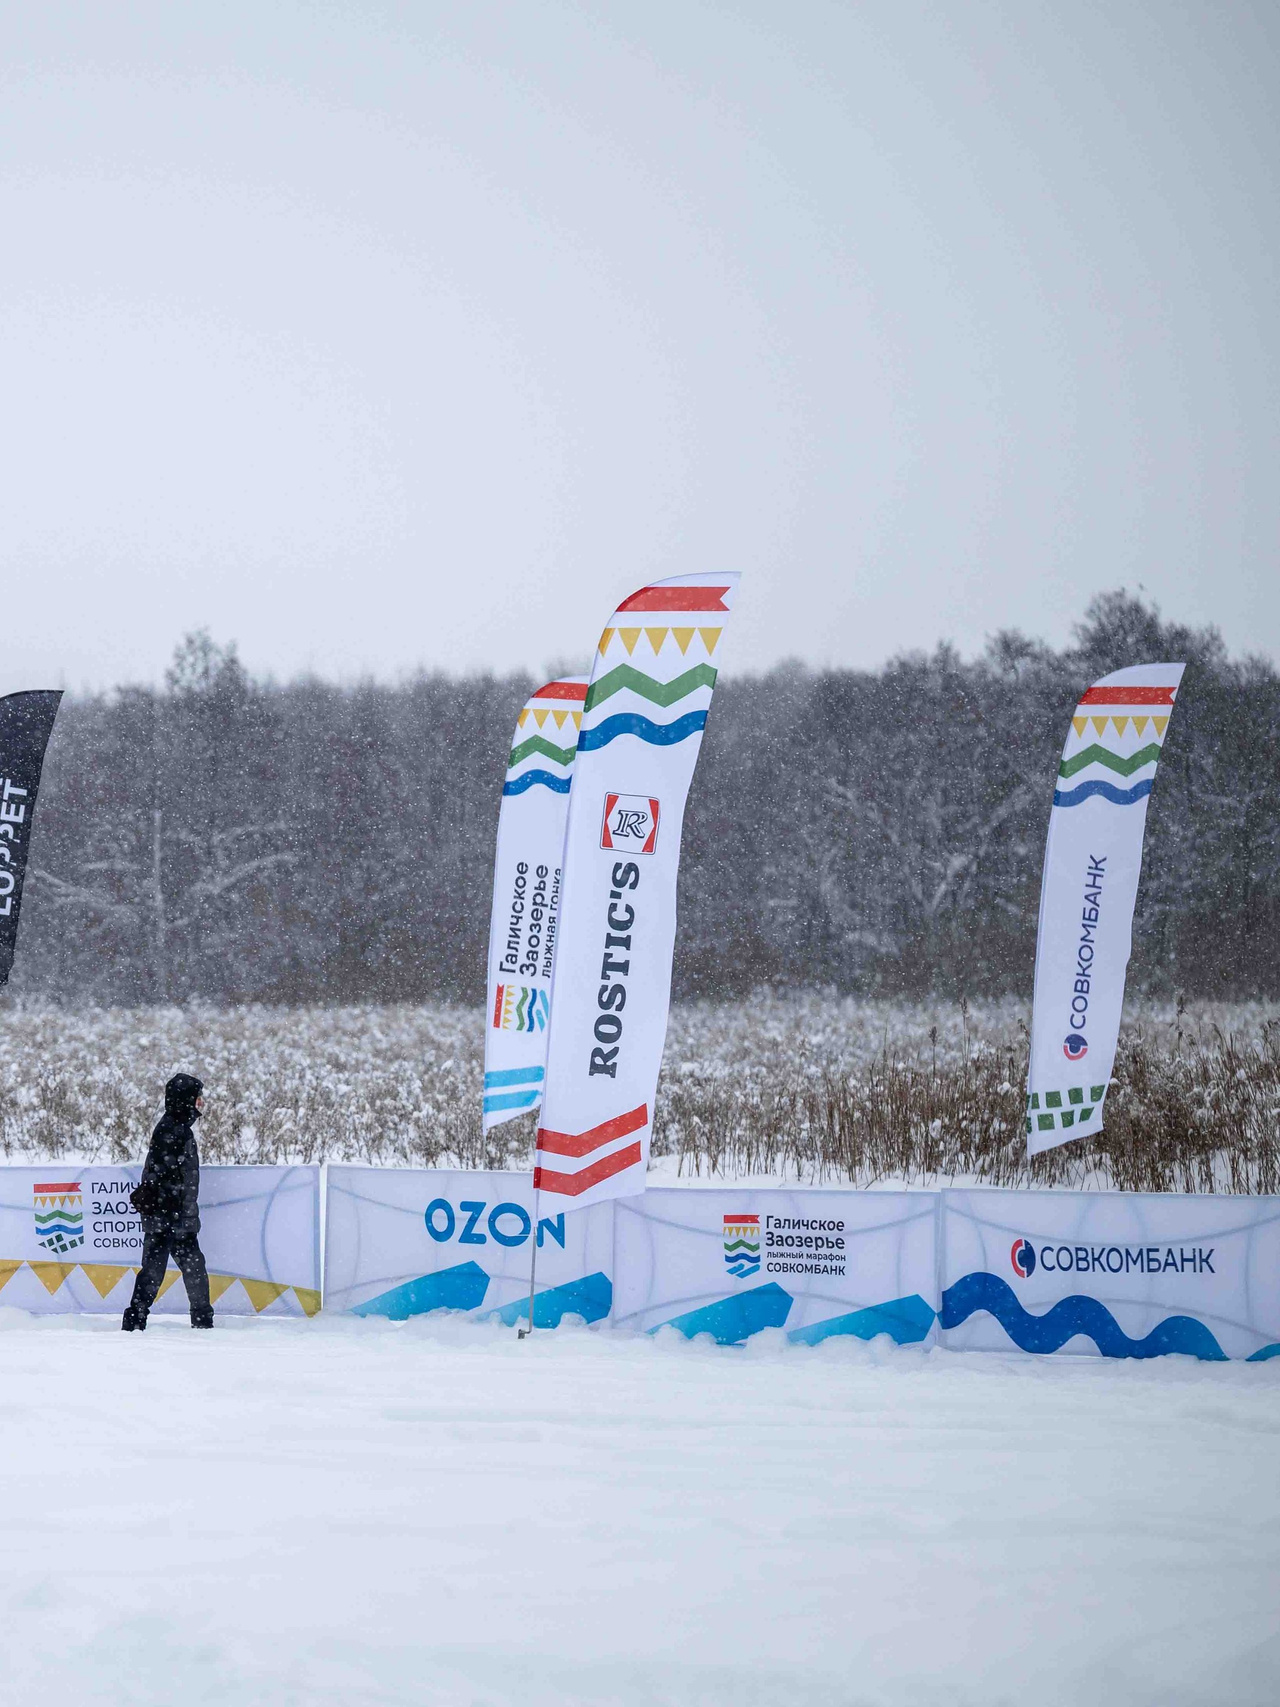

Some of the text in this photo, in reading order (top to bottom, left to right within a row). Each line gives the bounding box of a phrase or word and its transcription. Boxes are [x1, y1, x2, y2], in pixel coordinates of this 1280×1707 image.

[499, 861, 529, 974] Галичское
[519, 864, 549, 977] Заозерье
[542, 915, 557, 979] лыжная
[1069, 854, 1108, 1030] СОВКОМБАНК
[588, 861, 640, 1079] ROSTIC'S
[91, 1182, 141, 1194] ГАЛИЧ
[93, 1221, 142, 1233] СПОРТ
[424, 1198, 565, 1249] OZON
[766, 1215, 845, 1232] Галичское
[765, 1231, 845, 1251] Заозерье
[766, 1251, 846, 1263] лыжный марафон
[766, 1262, 846, 1276] СОВКОМБАНК
[1040, 1246, 1216, 1274] СОВКОМБАНК
